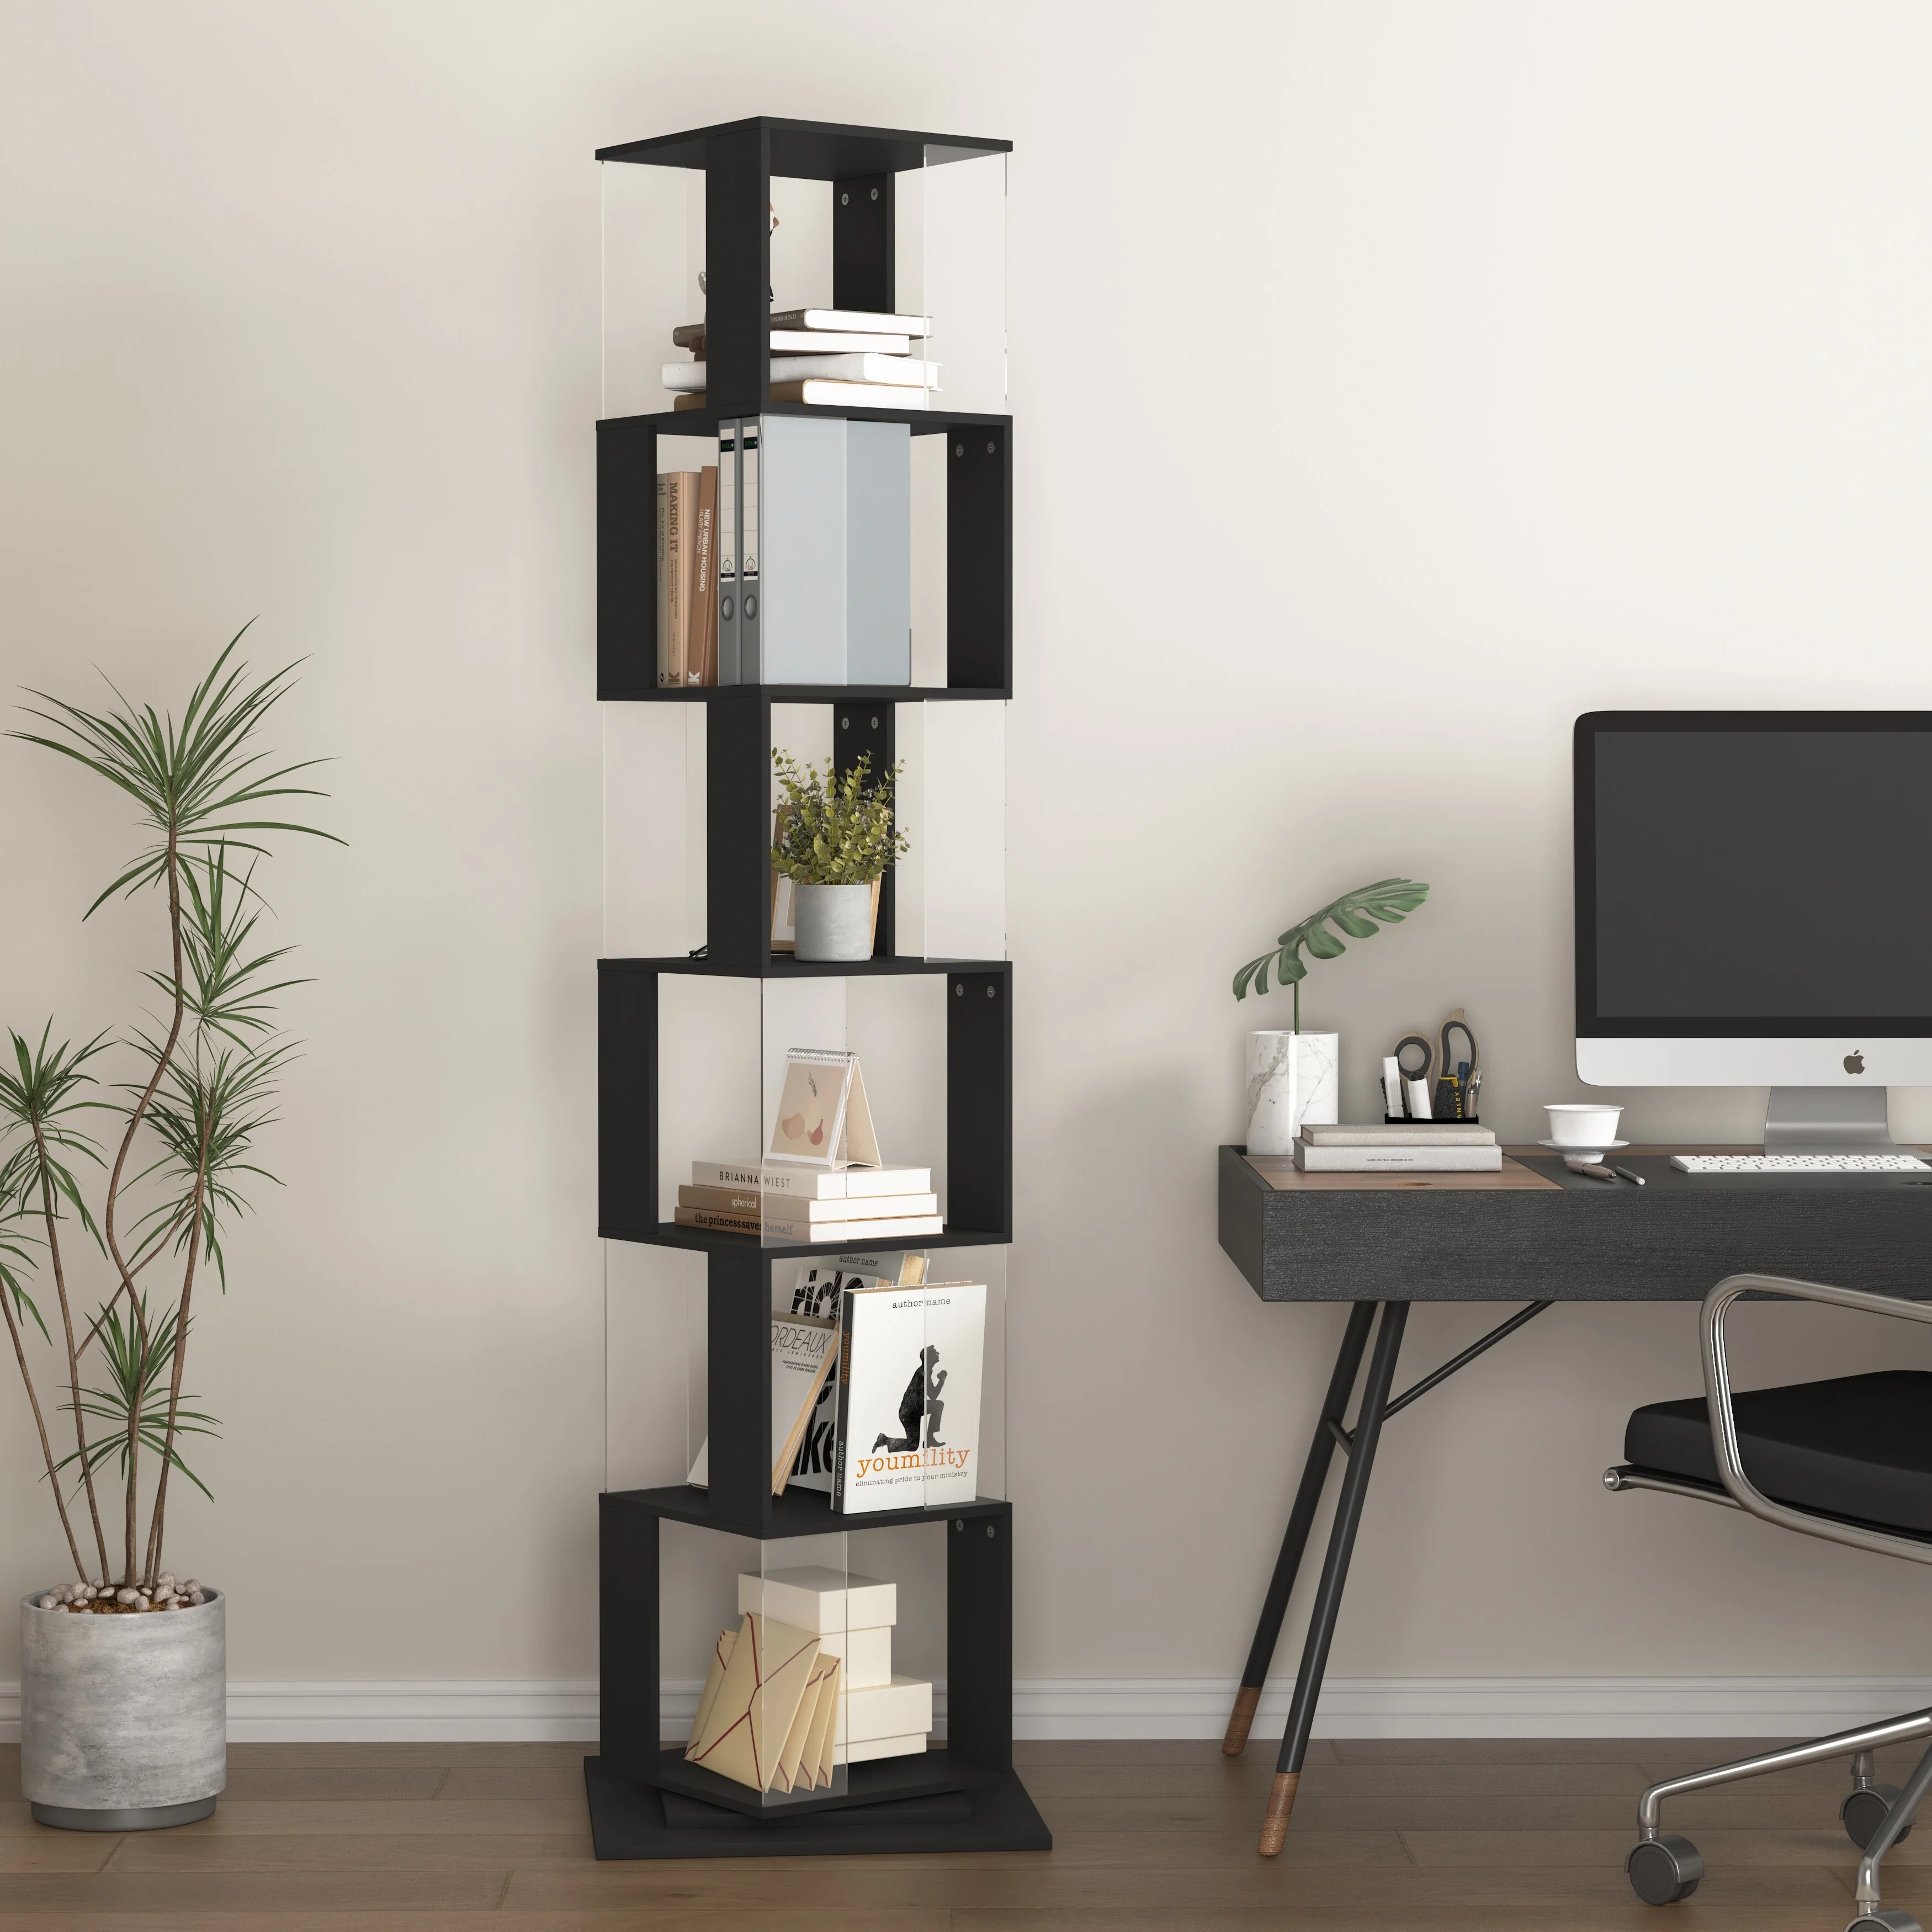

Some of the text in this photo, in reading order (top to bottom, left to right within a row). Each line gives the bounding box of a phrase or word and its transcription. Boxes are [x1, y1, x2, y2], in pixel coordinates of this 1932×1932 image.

[670, 482, 678, 553] MAKING IT
[699, 556, 707, 592] HOUSING
[719, 1171, 790, 1188] BRIANNA WIEST
[731, 1195, 757, 1209] spherical
[695, 1213, 793, 1235] the princess saves herself
[839, 1256, 878, 1267] author name
[892, 1297, 951, 1309] author name
[841, 1331, 850, 1385] youmility
[856, 1447, 970, 1478] youmility
[856, 1477, 893, 1487] eliminating
